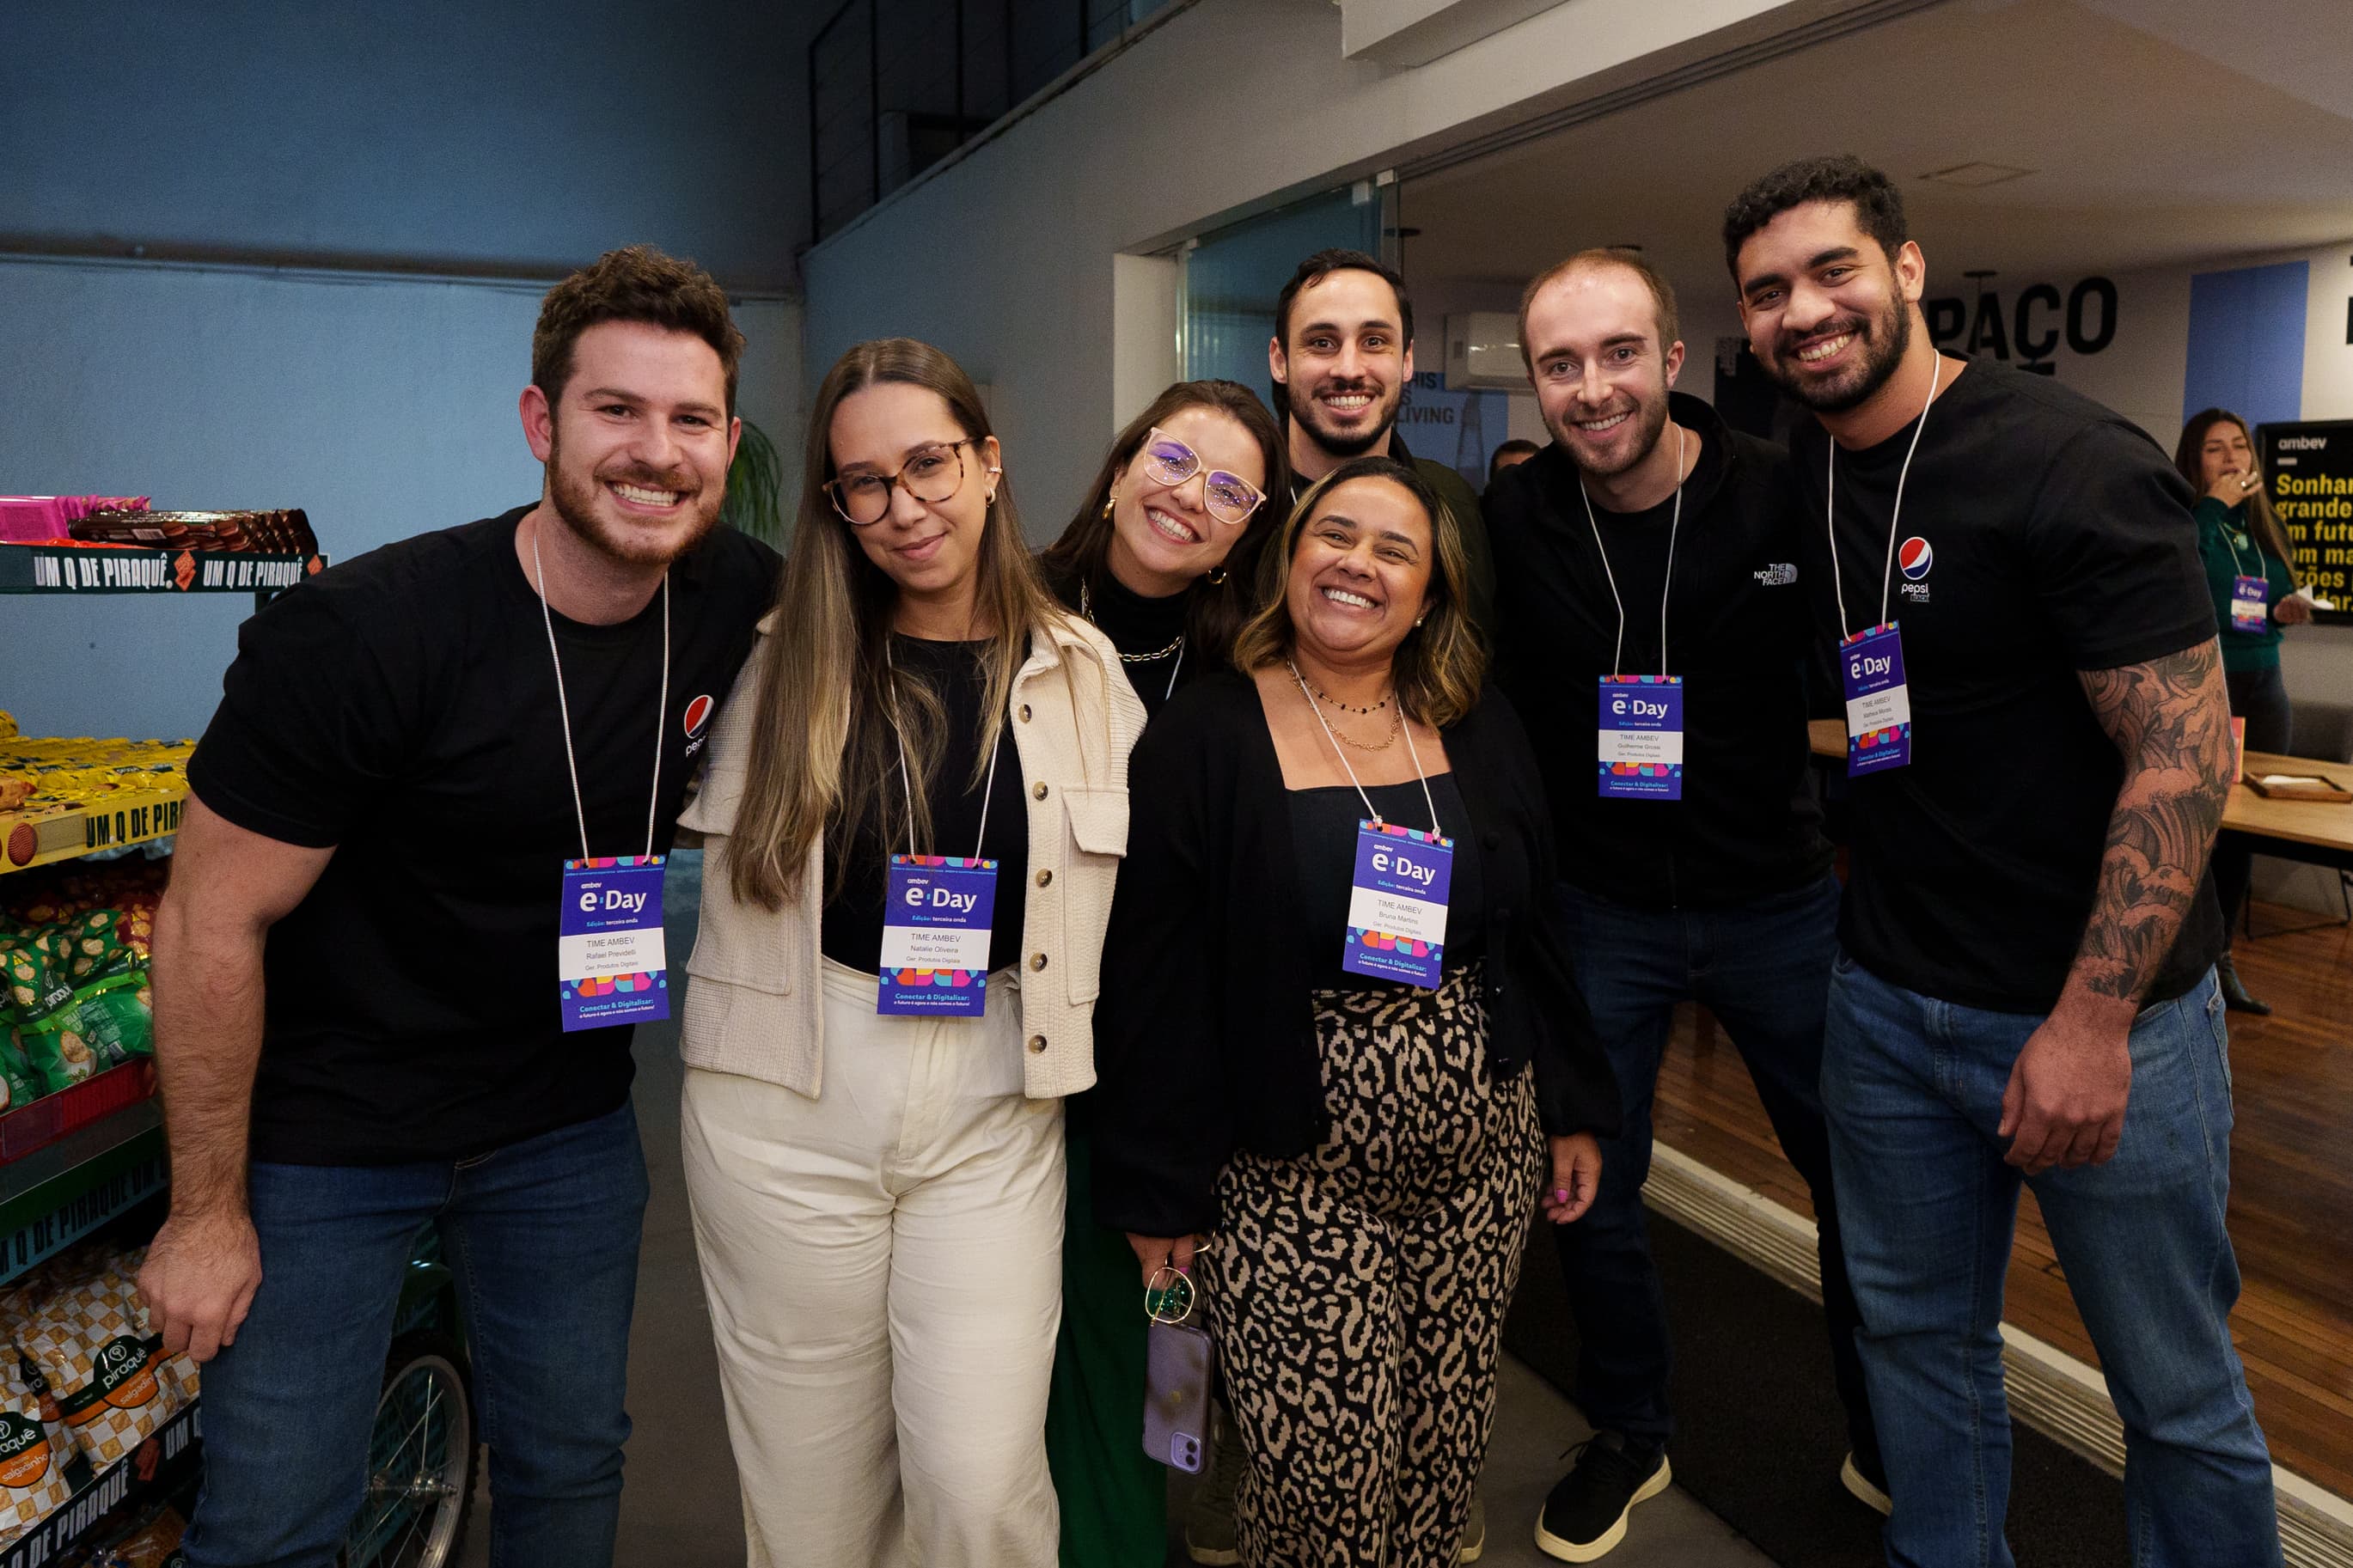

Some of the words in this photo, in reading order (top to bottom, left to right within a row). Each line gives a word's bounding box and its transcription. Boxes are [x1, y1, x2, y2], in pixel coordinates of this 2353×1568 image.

[1409, 372, 1437, 389] HIS
[2278, 437, 2327, 450] ambev
[34, 556, 61, 587] UM
[64, 557, 77, 589] Q
[79, 558, 100, 587] DE
[101, 552, 168, 589] PIRAQUÊ
[203, 560, 224, 587] UM
[226, 560, 236, 589] Q
[237, 560, 254, 587] DE
[254, 556, 303, 589] PIRAQUÊ
[1754, 570, 1786, 579] NORTH
[2295, 564, 2344, 588] zões
[1901, 583, 1928, 595] pepsi
[1863, 656, 1891, 675] Day
[1633, 699, 1668, 719] Day
[86, 814, 110, 848] UM
[115, 810, 125, 844] Q
[131, 806, 149, 839] DE
[1396, 857, 1436, 886] Day
[605, 890, 646, 912] Day
[932, 888, 977, 913] Day
[1377, 900, 1396, 910] TIME
[1397, 904, 1423, 915] AMBEV
[587, 939, 605, 949] TIME
[607, 937, 635, 947] AMBEV
[911, 933, 931, 942] TIME
[932, 934, 961, 943] AMBEV
[586, 952, 607, 961] Rafael
[579, 1004, 610, 1013] Conectar
[102, 1347, 147, 1389] piraquê
[166, 1416, 189, 1460] UM
[28, 1526, 52, 1568] DE
[56, 1457, 130, 1552] PIRAQUÊ
